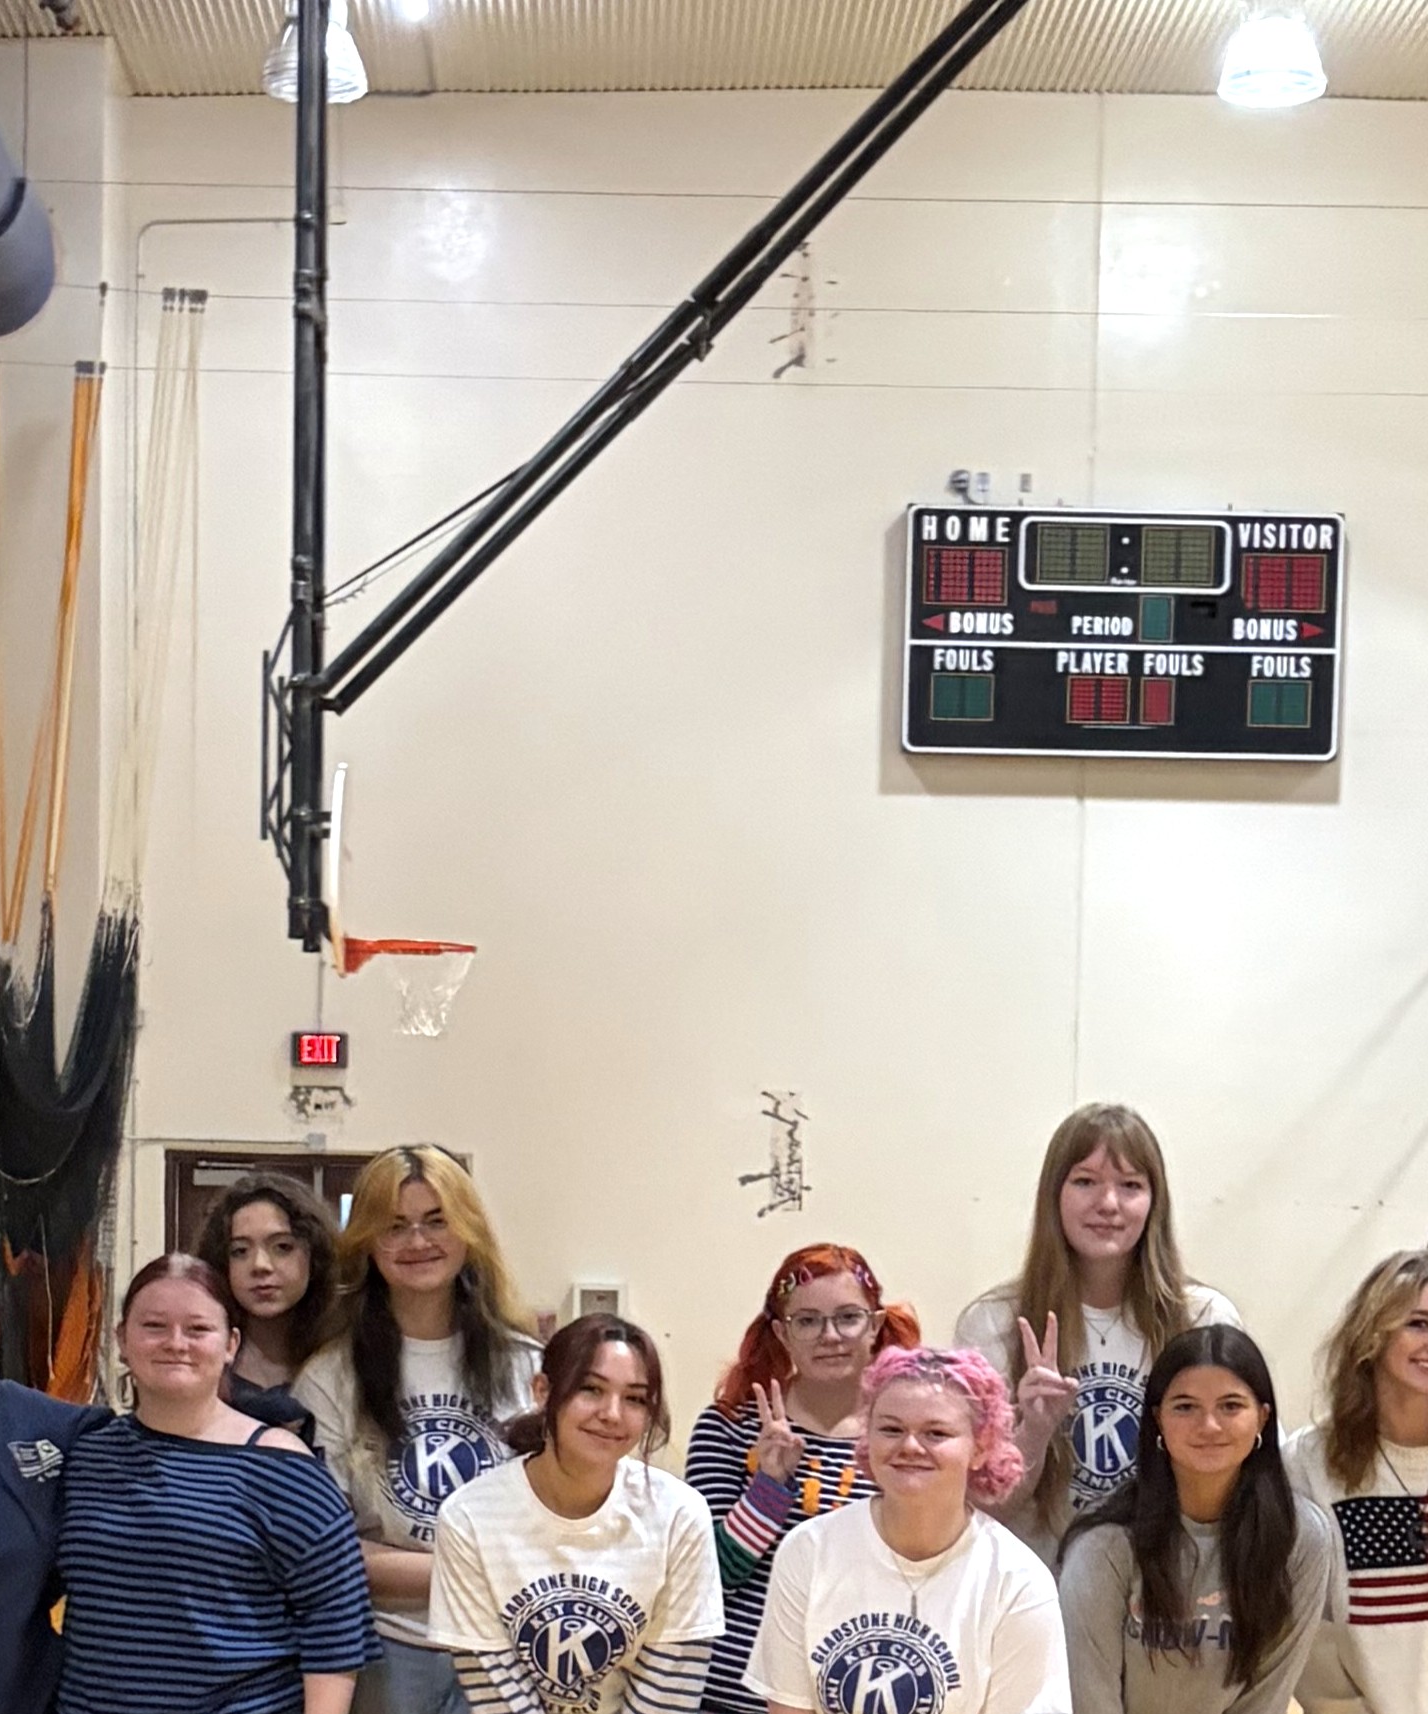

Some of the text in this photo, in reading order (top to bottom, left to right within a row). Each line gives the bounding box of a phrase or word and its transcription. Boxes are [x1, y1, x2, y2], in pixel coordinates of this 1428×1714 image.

[923, 516, 1011, 543] HOME
[1238, 523, 1334, 550] VISITOR
[948, 611, 1014, 634] BONUS
[1071, 615, 1133, 636] PERIOD
[1232, 619, 1298, 641] BONUS
[933, 649, 994, 671] FOULS
[1056, 652, 1204, 676] PLAYER FOULS
[1251, 655, 1312, 678] FOULS
[299, 1035, 340, 1063] EXIT
[1076, 1391, 1095, 1407] EY
[435, 1420, 481, 1443] CLUB
[571, 1573, 610, 1595] HIGH
[611, 1588, 648, 1633] SCHO
[529, 1602, 618, 1634] KEY CLUB
[810, 1612, 962, 1692] GLADSTONE HIGH SCHOOL
[843, 1641, 928, 1677] KEY CLUB
